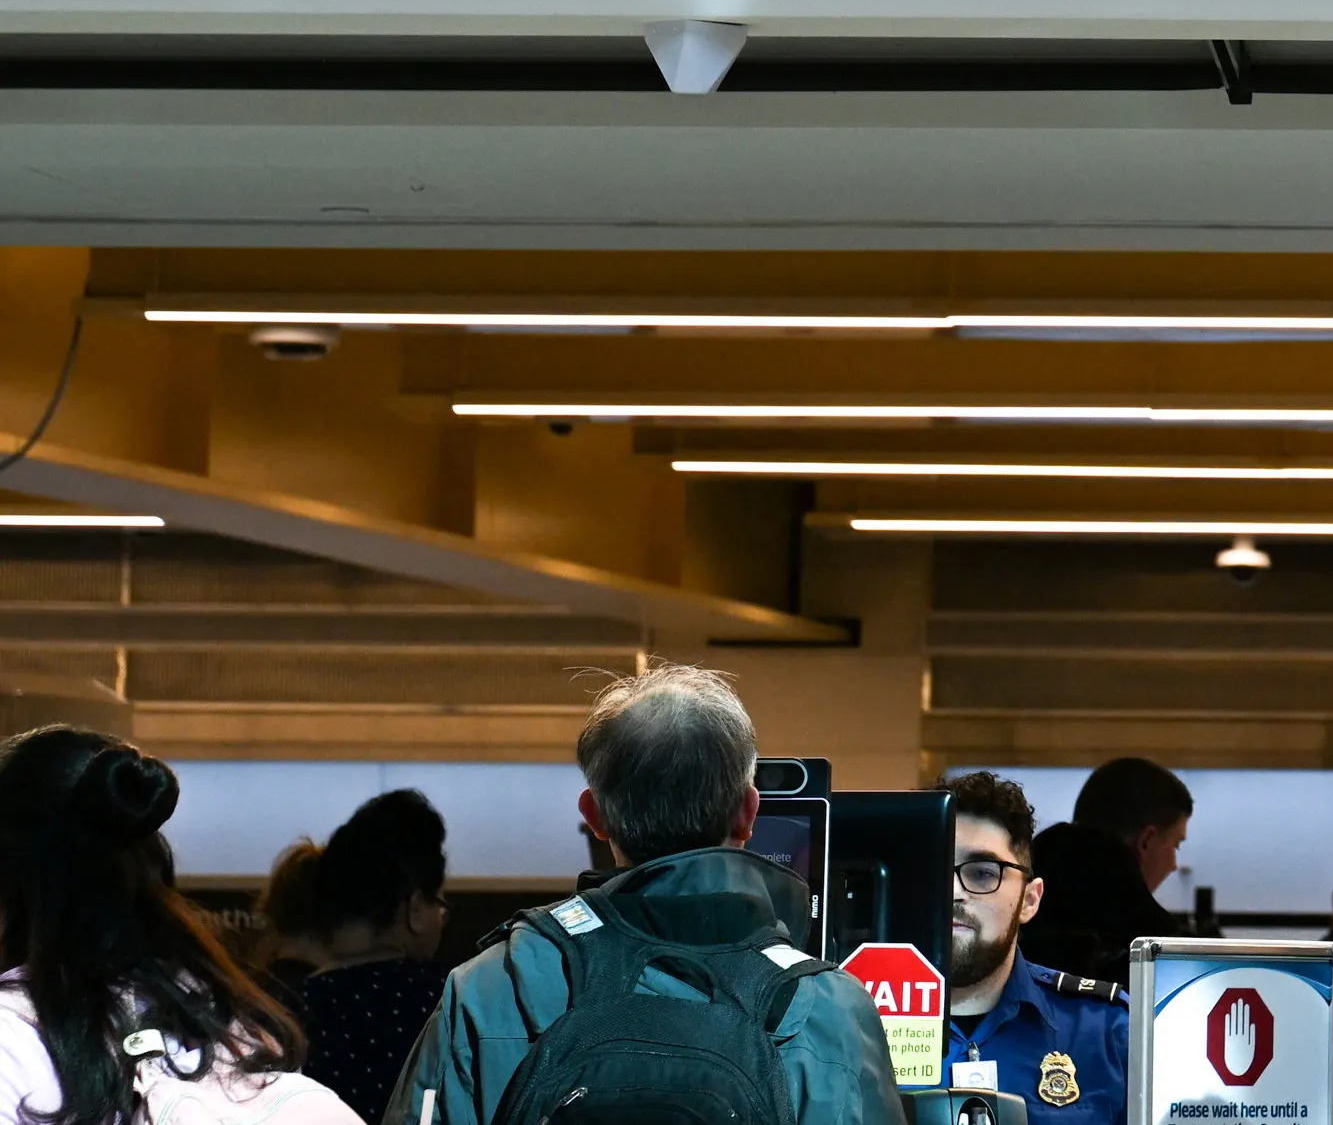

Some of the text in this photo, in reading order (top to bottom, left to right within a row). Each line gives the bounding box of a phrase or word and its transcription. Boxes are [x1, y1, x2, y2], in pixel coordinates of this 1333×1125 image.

[811, 894, 819, 919] mimo
[1078, 977, 1097, 991] TS
[892, 1027, 903, 1038] of
[906, 1027, 935, 1038] facial
[901, 1042, 931, 1054] photo
[894, 1064, 934, 1076] sert ID
[1170, 1102, 1308, 1118] Please wait here until a
